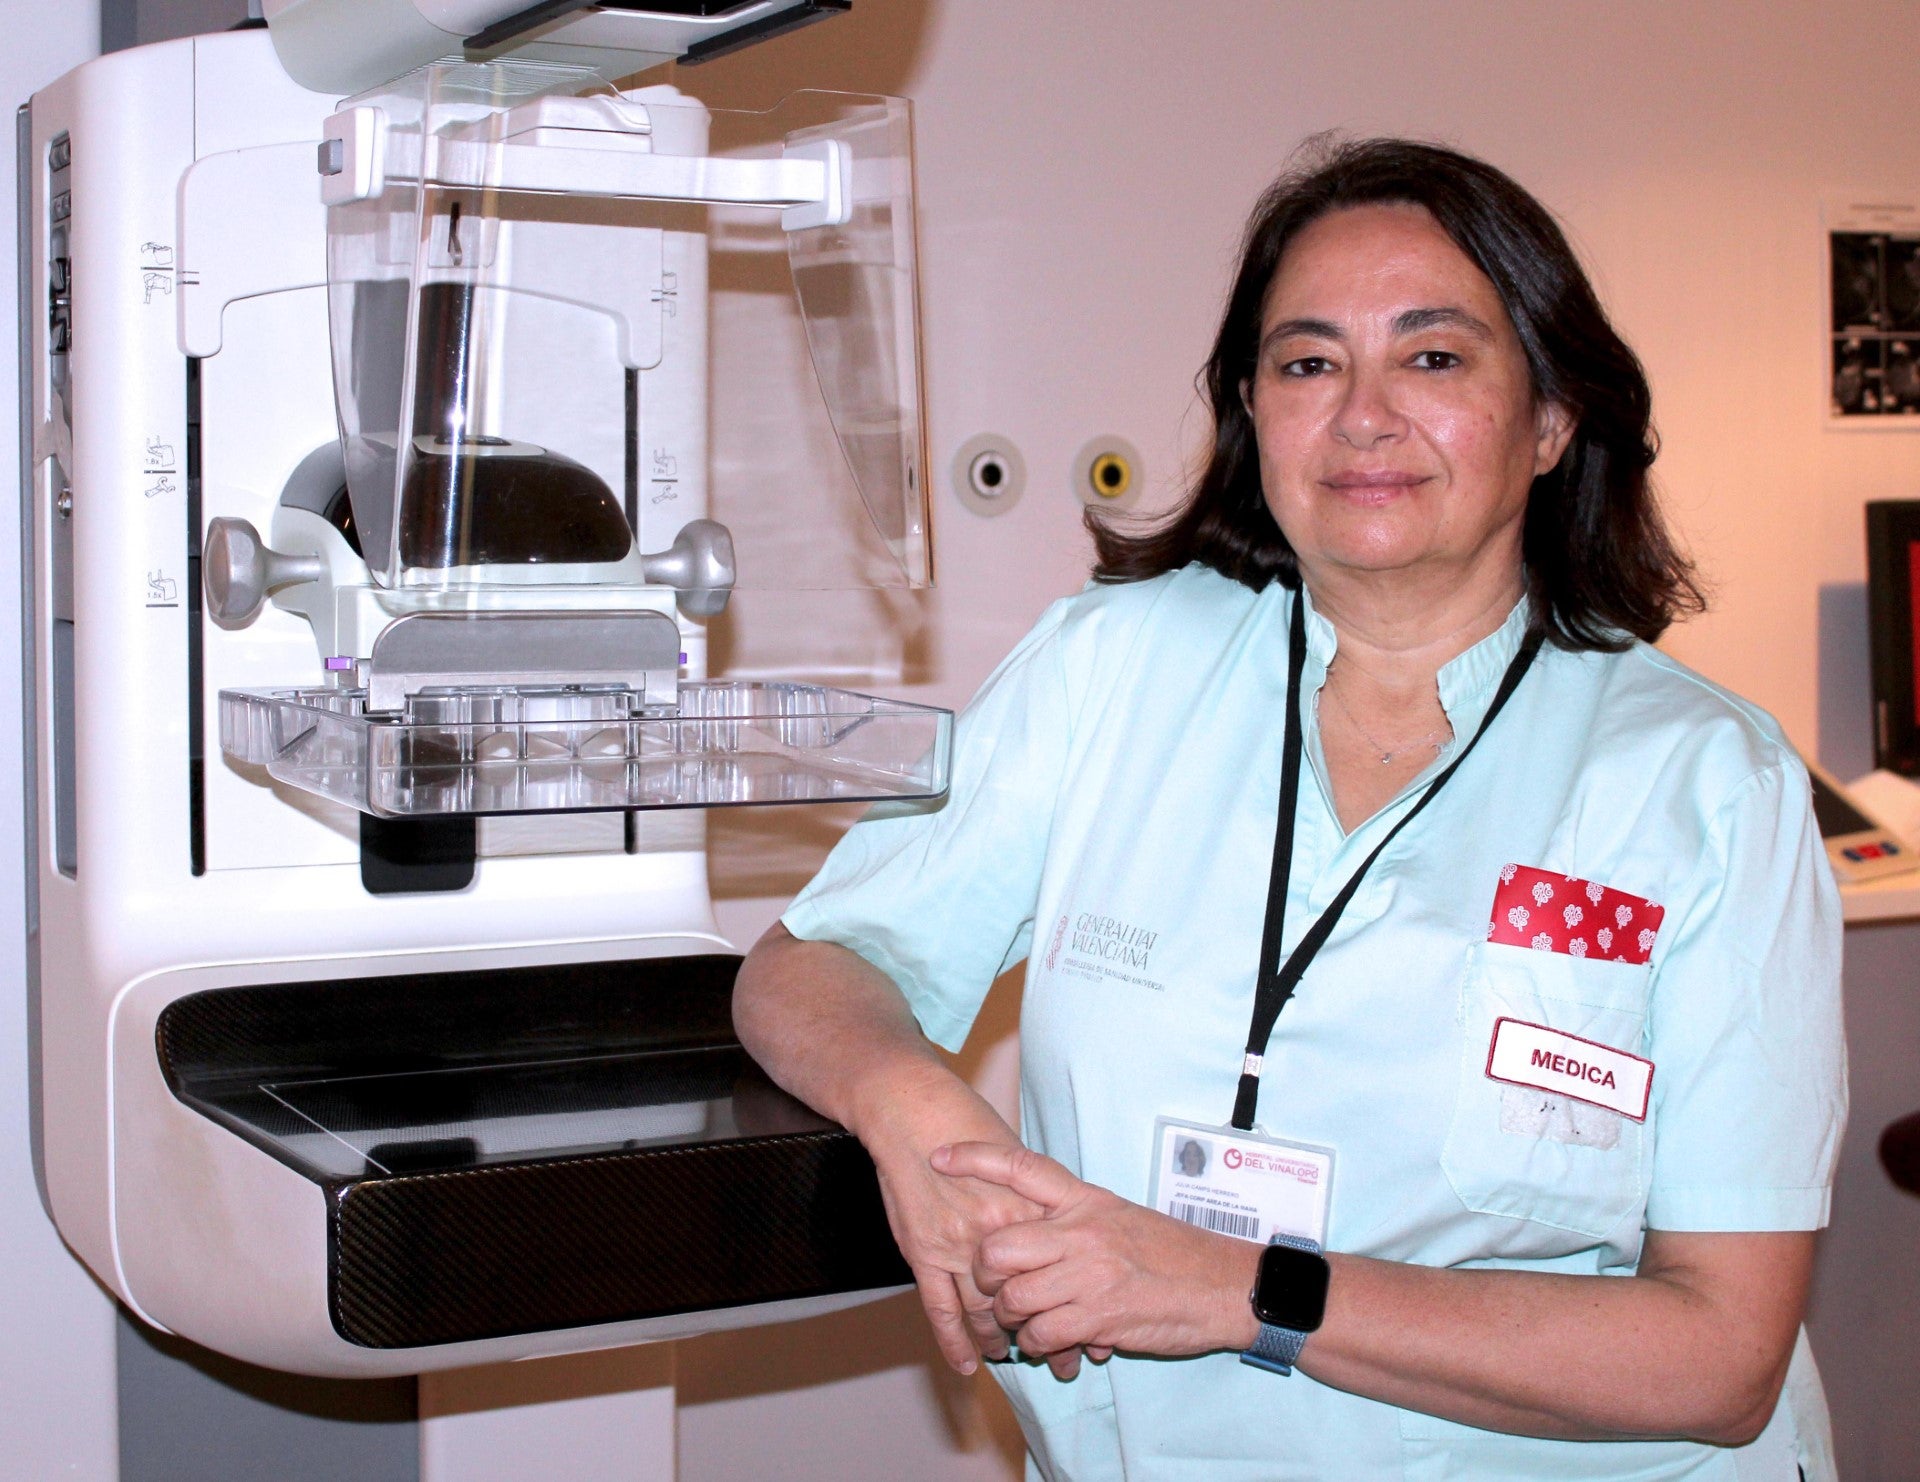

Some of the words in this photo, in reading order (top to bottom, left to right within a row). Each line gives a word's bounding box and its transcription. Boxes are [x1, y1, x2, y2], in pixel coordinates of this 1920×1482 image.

[1077, 913, 1159, 950] GENERALITAT
[1071, 931, 1148, 970] VALENCIANA
[1531, 1048, 1616, 1089] MEDICA
[1245, 1157, 1264, 1170] DEL
[1268, 1162, 1319, 1179] VINALOPÓ
[1211, 1188, 1239, 1198] HERRERO
